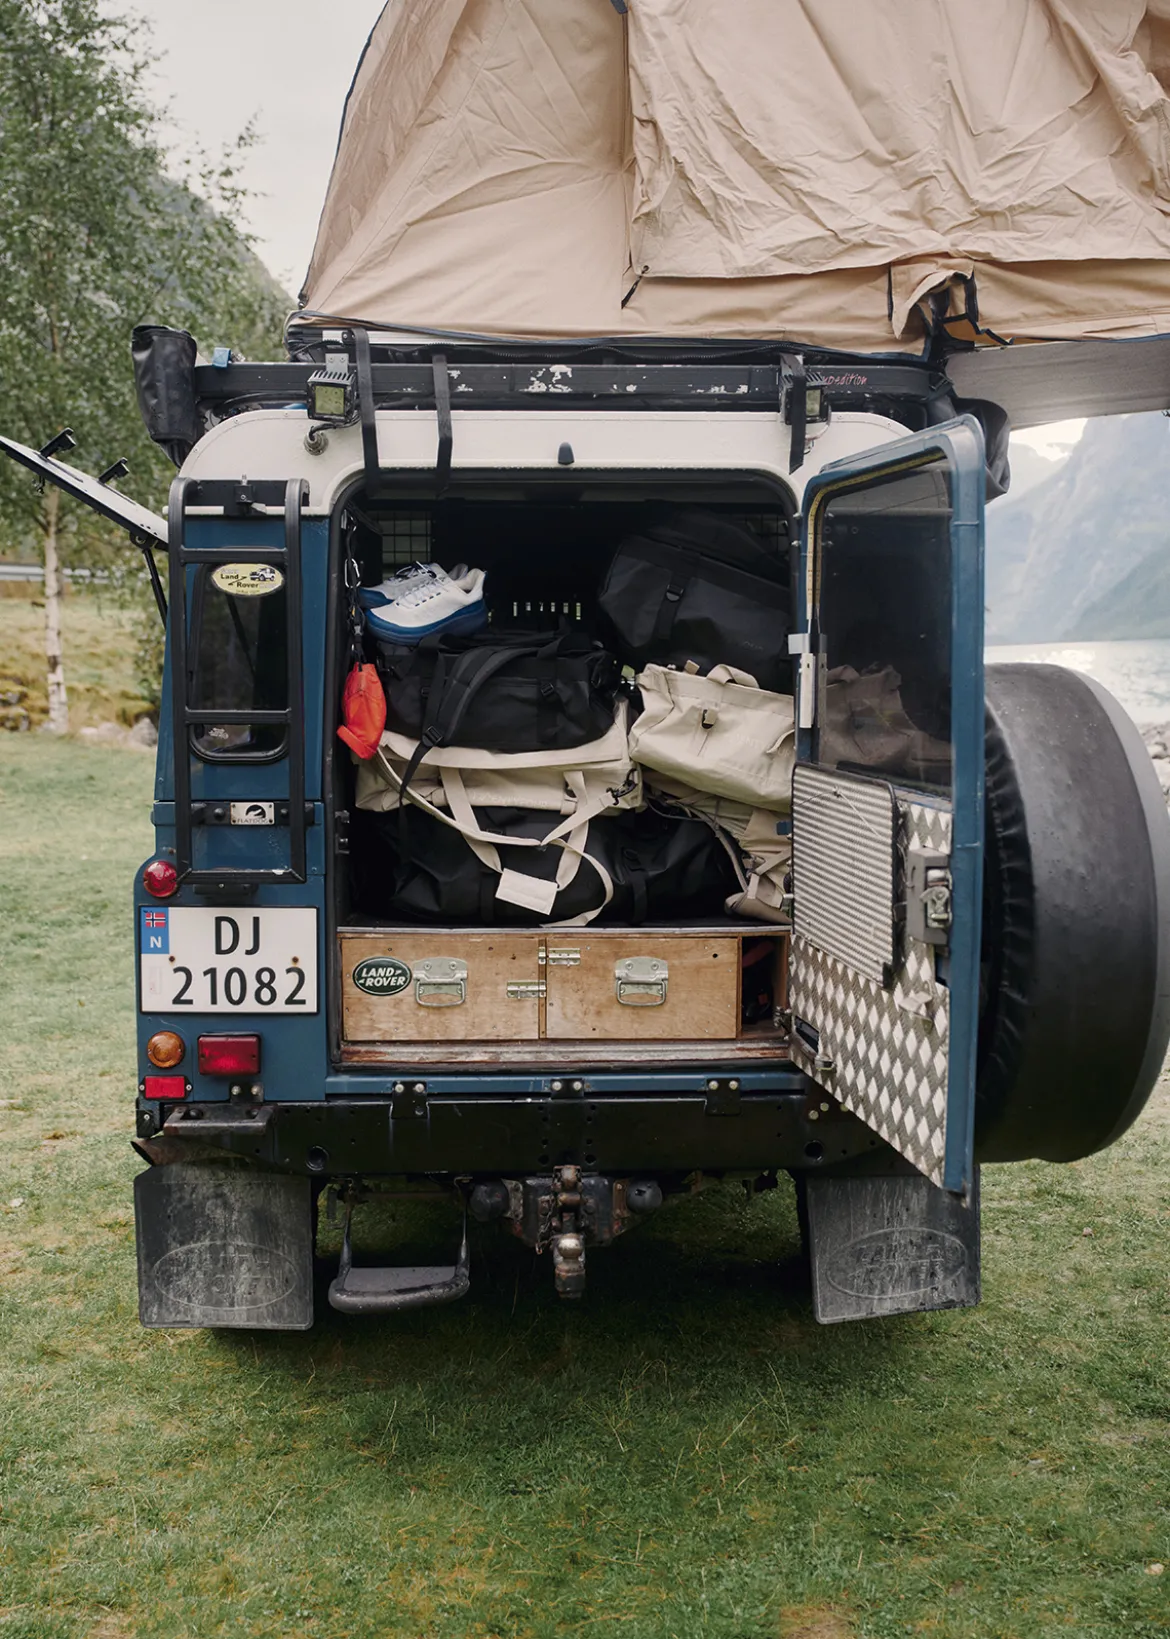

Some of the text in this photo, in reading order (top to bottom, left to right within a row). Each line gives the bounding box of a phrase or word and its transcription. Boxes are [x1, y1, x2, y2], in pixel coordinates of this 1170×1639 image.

[821, 373, 868, 385] xpedition
[214, 915, 261, 956] DJ
[149, 936, 162, 948] N
[361, 967, 395, 978] LAND
[172, 966, 307, 1006] 21082
[365, 976, 406, 987] ROVER
